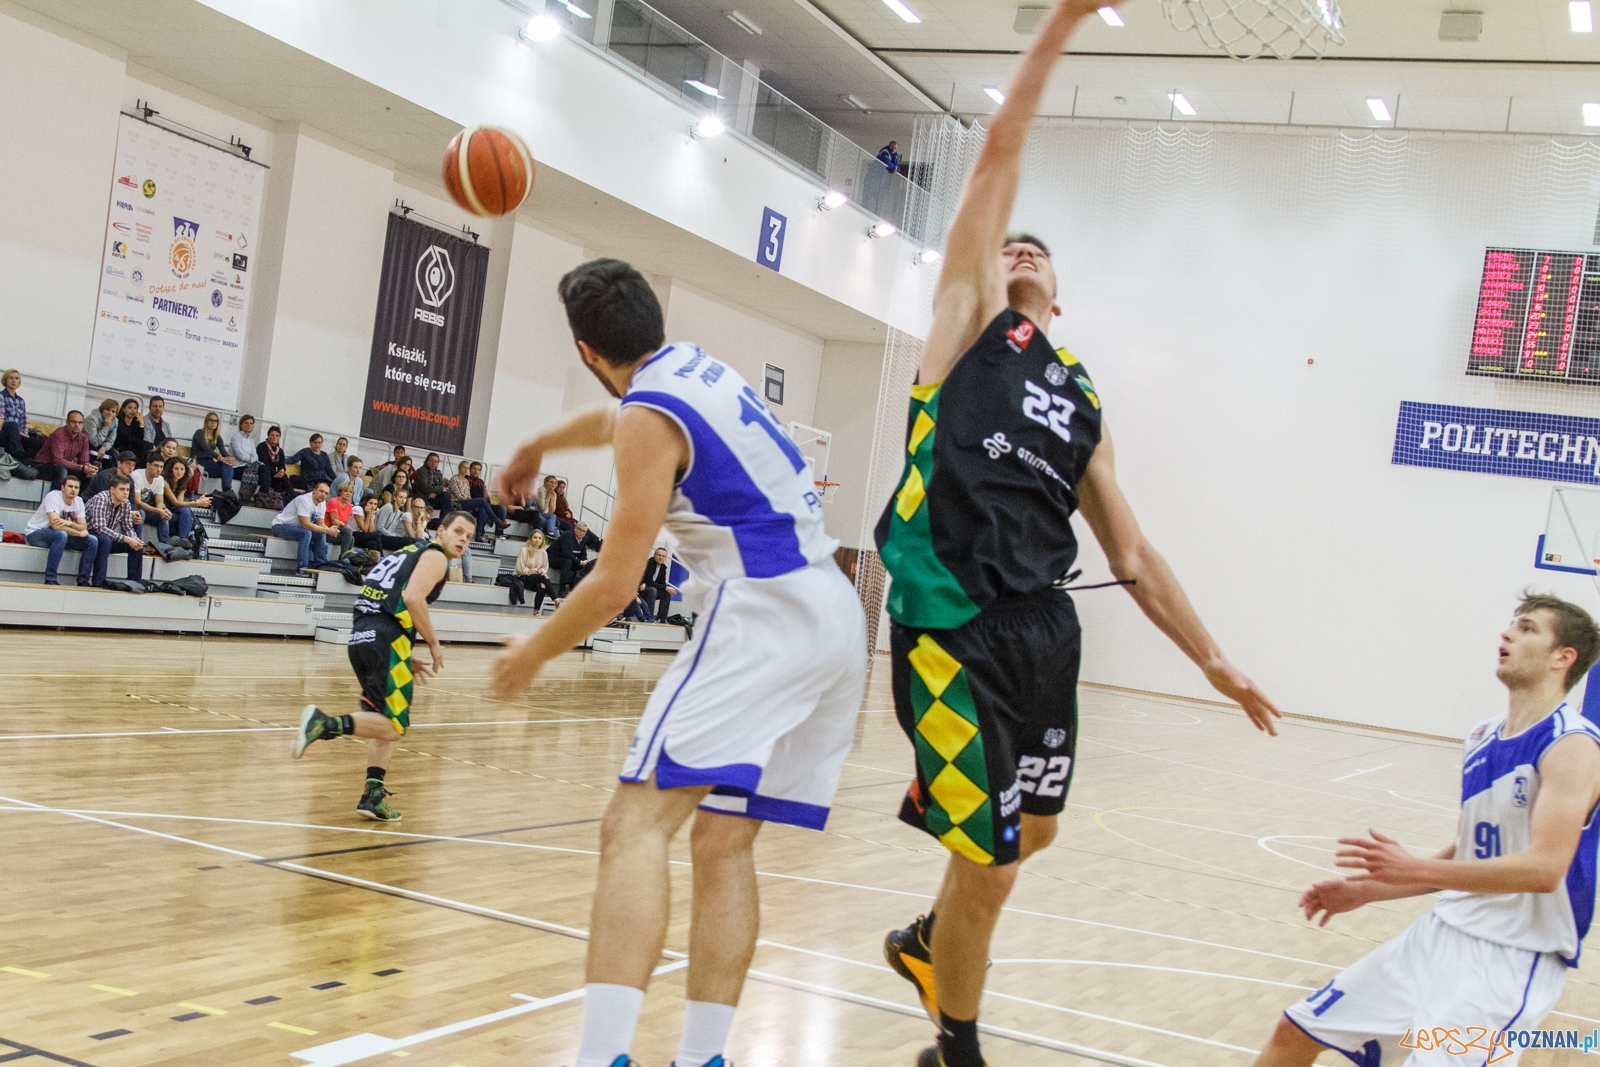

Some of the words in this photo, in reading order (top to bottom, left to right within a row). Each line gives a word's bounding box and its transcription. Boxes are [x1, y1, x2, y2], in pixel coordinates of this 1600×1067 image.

[765, 216, 782, 262] 3
[1545, 255, 1550, 263] 7
[1575, 257, 1583, 265] 0
[149, 283, 177, 294] Dołącz
[180, 281, 190, 291] do
[1572, 276, 1579, 284] 0
[152, 297, 199, 320] PARTNERZY:
[414, 307, 445, 327] REBIS
[388, 341, 427, 367] Książki,
[1525, 341, 1536, 349] 55
[1560, 352, 1567, 360] 0
[1558, 362, 1565, 370] 0
[385, 365, 412, 383] które
[414, 374, 429, 390] się
[431, 380, 456, 395] czyta
[372, 400, 460, 429] www.rebis.com.pl
[1022, 380, 1076, 443] 22
[366, 554, 407, 588] 82
[1016, 755, 1071, 797] 22
[1474, 821, 1502, 859] 91
